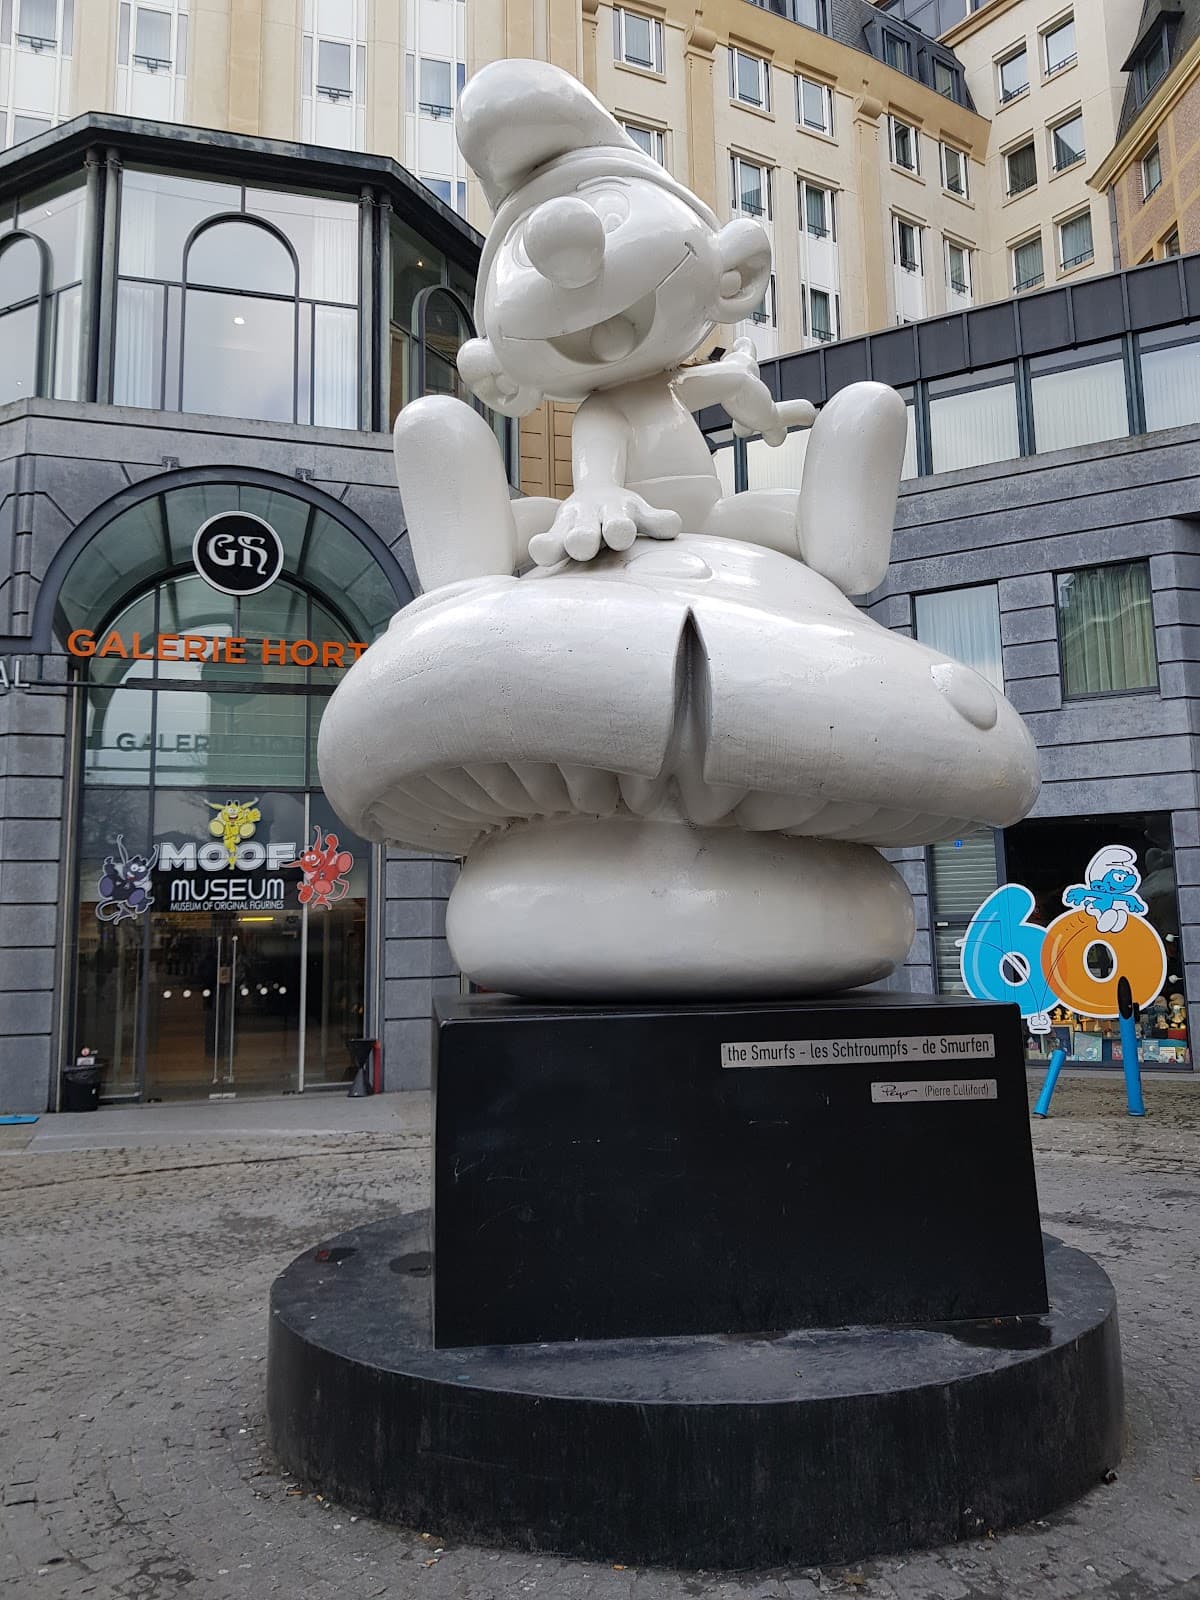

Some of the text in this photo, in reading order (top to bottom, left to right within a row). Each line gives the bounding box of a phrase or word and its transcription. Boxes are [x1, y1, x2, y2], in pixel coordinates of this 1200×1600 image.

[67, 628, 368, 668] GALERIE HORT
[158, 841, 297, 872] MOOF
[170, 878, 285, 901] MUSEUM
[170, 900, 285, 911] MUSEUM OF ORIGINAL FIGURINES
[727, 1045, 747, 1061] the
[751, 1044, 796, 1061] Smurfs
[810, 1042, 829, 1059] les
[832, 1040, 908, 1060] Schtroumpfs
[922, 1039, 936, 1054] de
[939, 1037, 989, 1054] Smurfen
[924, 1085, 951, 1098] (Pierre
[953, 1083, 989, 1097] Culliford)
